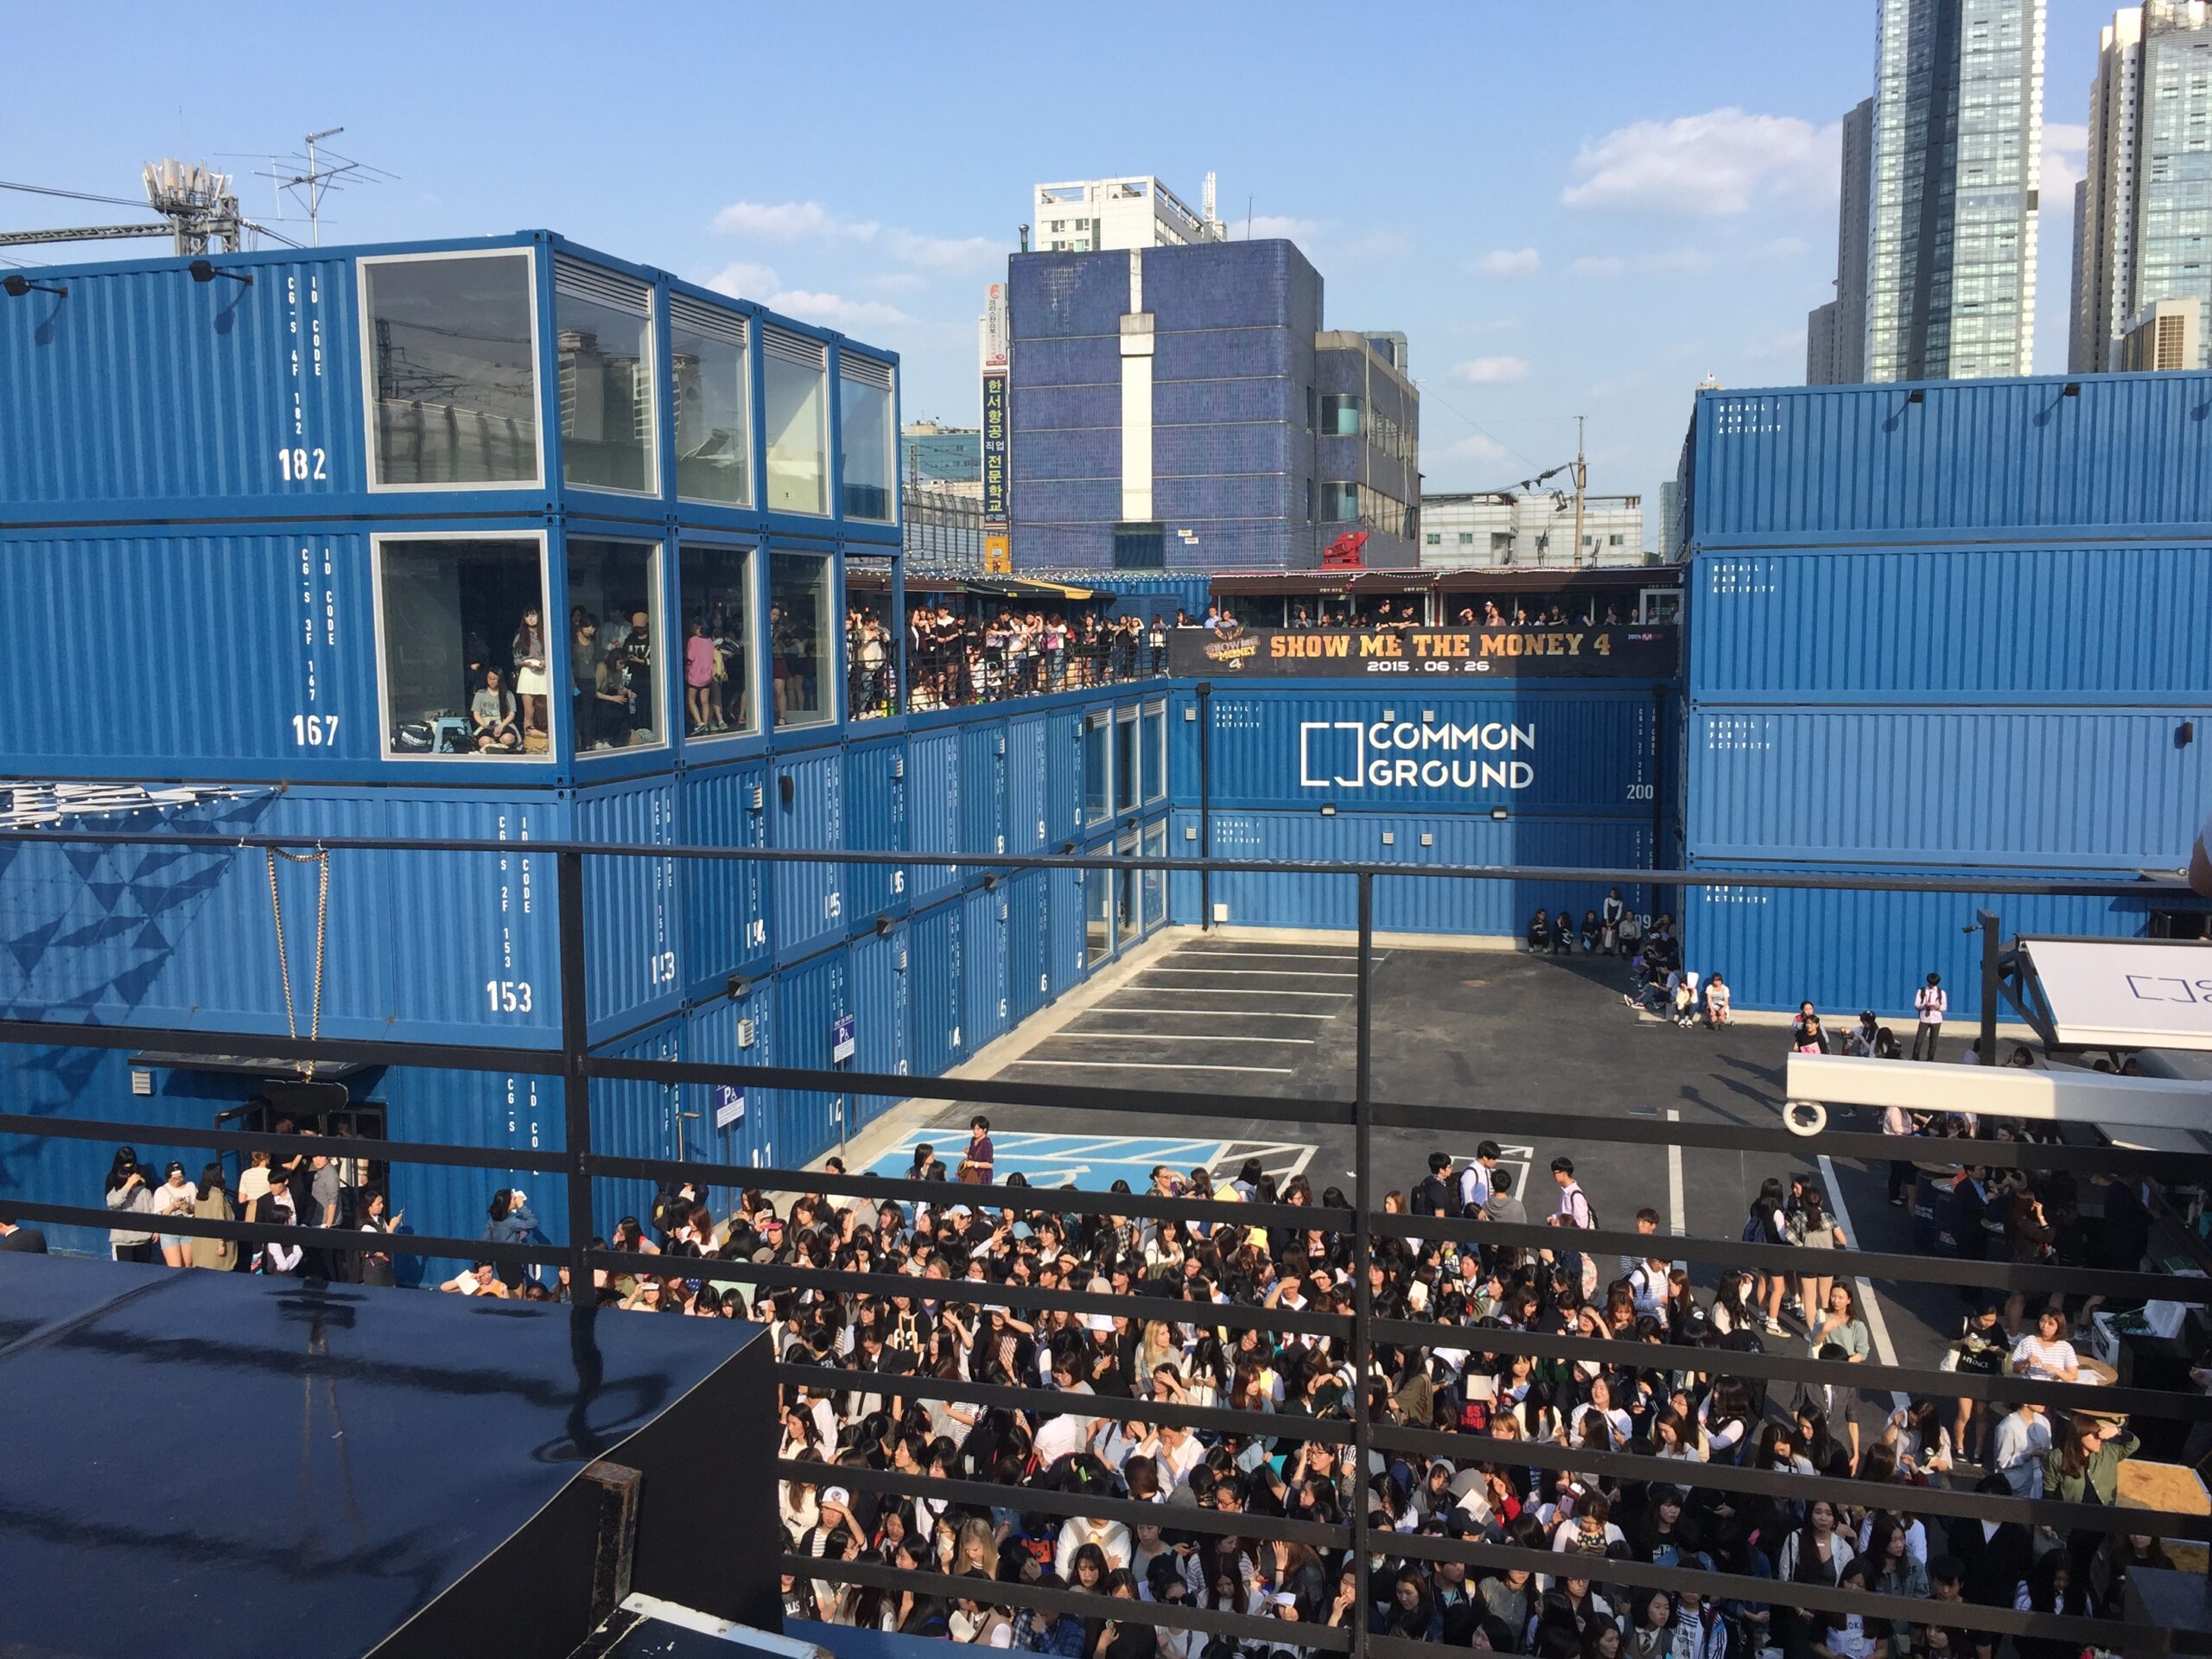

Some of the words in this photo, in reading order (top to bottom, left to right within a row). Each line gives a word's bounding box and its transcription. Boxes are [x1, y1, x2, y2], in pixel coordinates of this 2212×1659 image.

[311, 276, 318, 303] ID
[313, 320, 321, 376] CODE
[292, 349, 299, 377] 4F
[987, 379, 1003, 439] 한서항공
[1719, 404, 1765, 412] RETAIL
[1719, 424, 1781, 434] ACTIVITY
[278, 448, 327, 480] 182
[987, 454, 1003, 512] 전문학교
[324, 548, 331, 575] ID
[326, 590, 334, 645] CODE
[305, 619, 312, 645] 3F
[1270, 635, 1351, 658] SHOW
[1359, 635, 1402, 658] ME
[1412, 634, 1470, 657] THE
[1480, 633, 1583, 657] MONEY
[1593, 633, 1611, 656] 4
[1229, 658, 1243, 669] 4
[1367, 661, 1409, 671] 2015
[1425, 661, 1450, 671] 06
[1464, 661, 1490, 671] 26
[292, 715, 339, 746] 167
[1369, 722, 1535, 750] COMMON
[1369, 760, 1534, 789] GROUND
[1626, 784, 1654, 799] 200
[501, 887, 508, 912] 2F
[522, 859, 531, 913] CODE
[1706, 894, 1767, 904] ACTIVITY
[486, 980, 532, 1013] 153
[531, 1080, 537, 1107] ID
[724, 1086, 731, 1105] P
